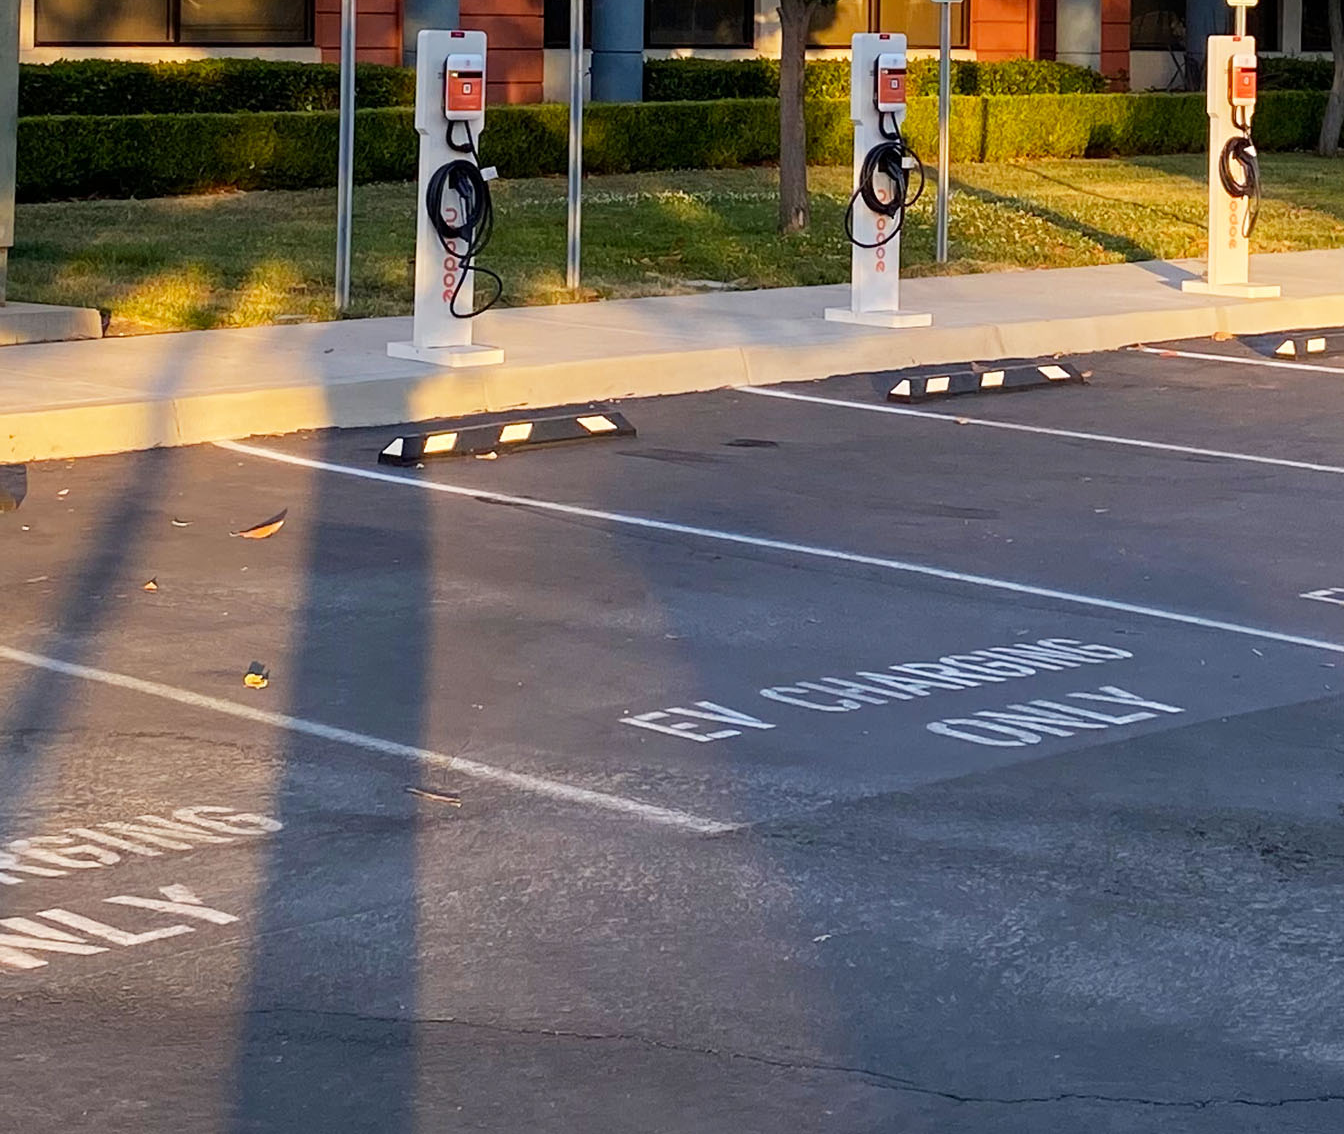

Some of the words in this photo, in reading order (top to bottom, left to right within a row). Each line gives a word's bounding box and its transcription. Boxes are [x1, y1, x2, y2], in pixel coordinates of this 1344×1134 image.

[442, 207, 459, 303] nodoe
[875, 188, 887, 273] nodoe
[617, 701, 776, 743] EV
[760, 638, 1133, 712] CHARGING
[926, 685, 1186, 747] ONLY
